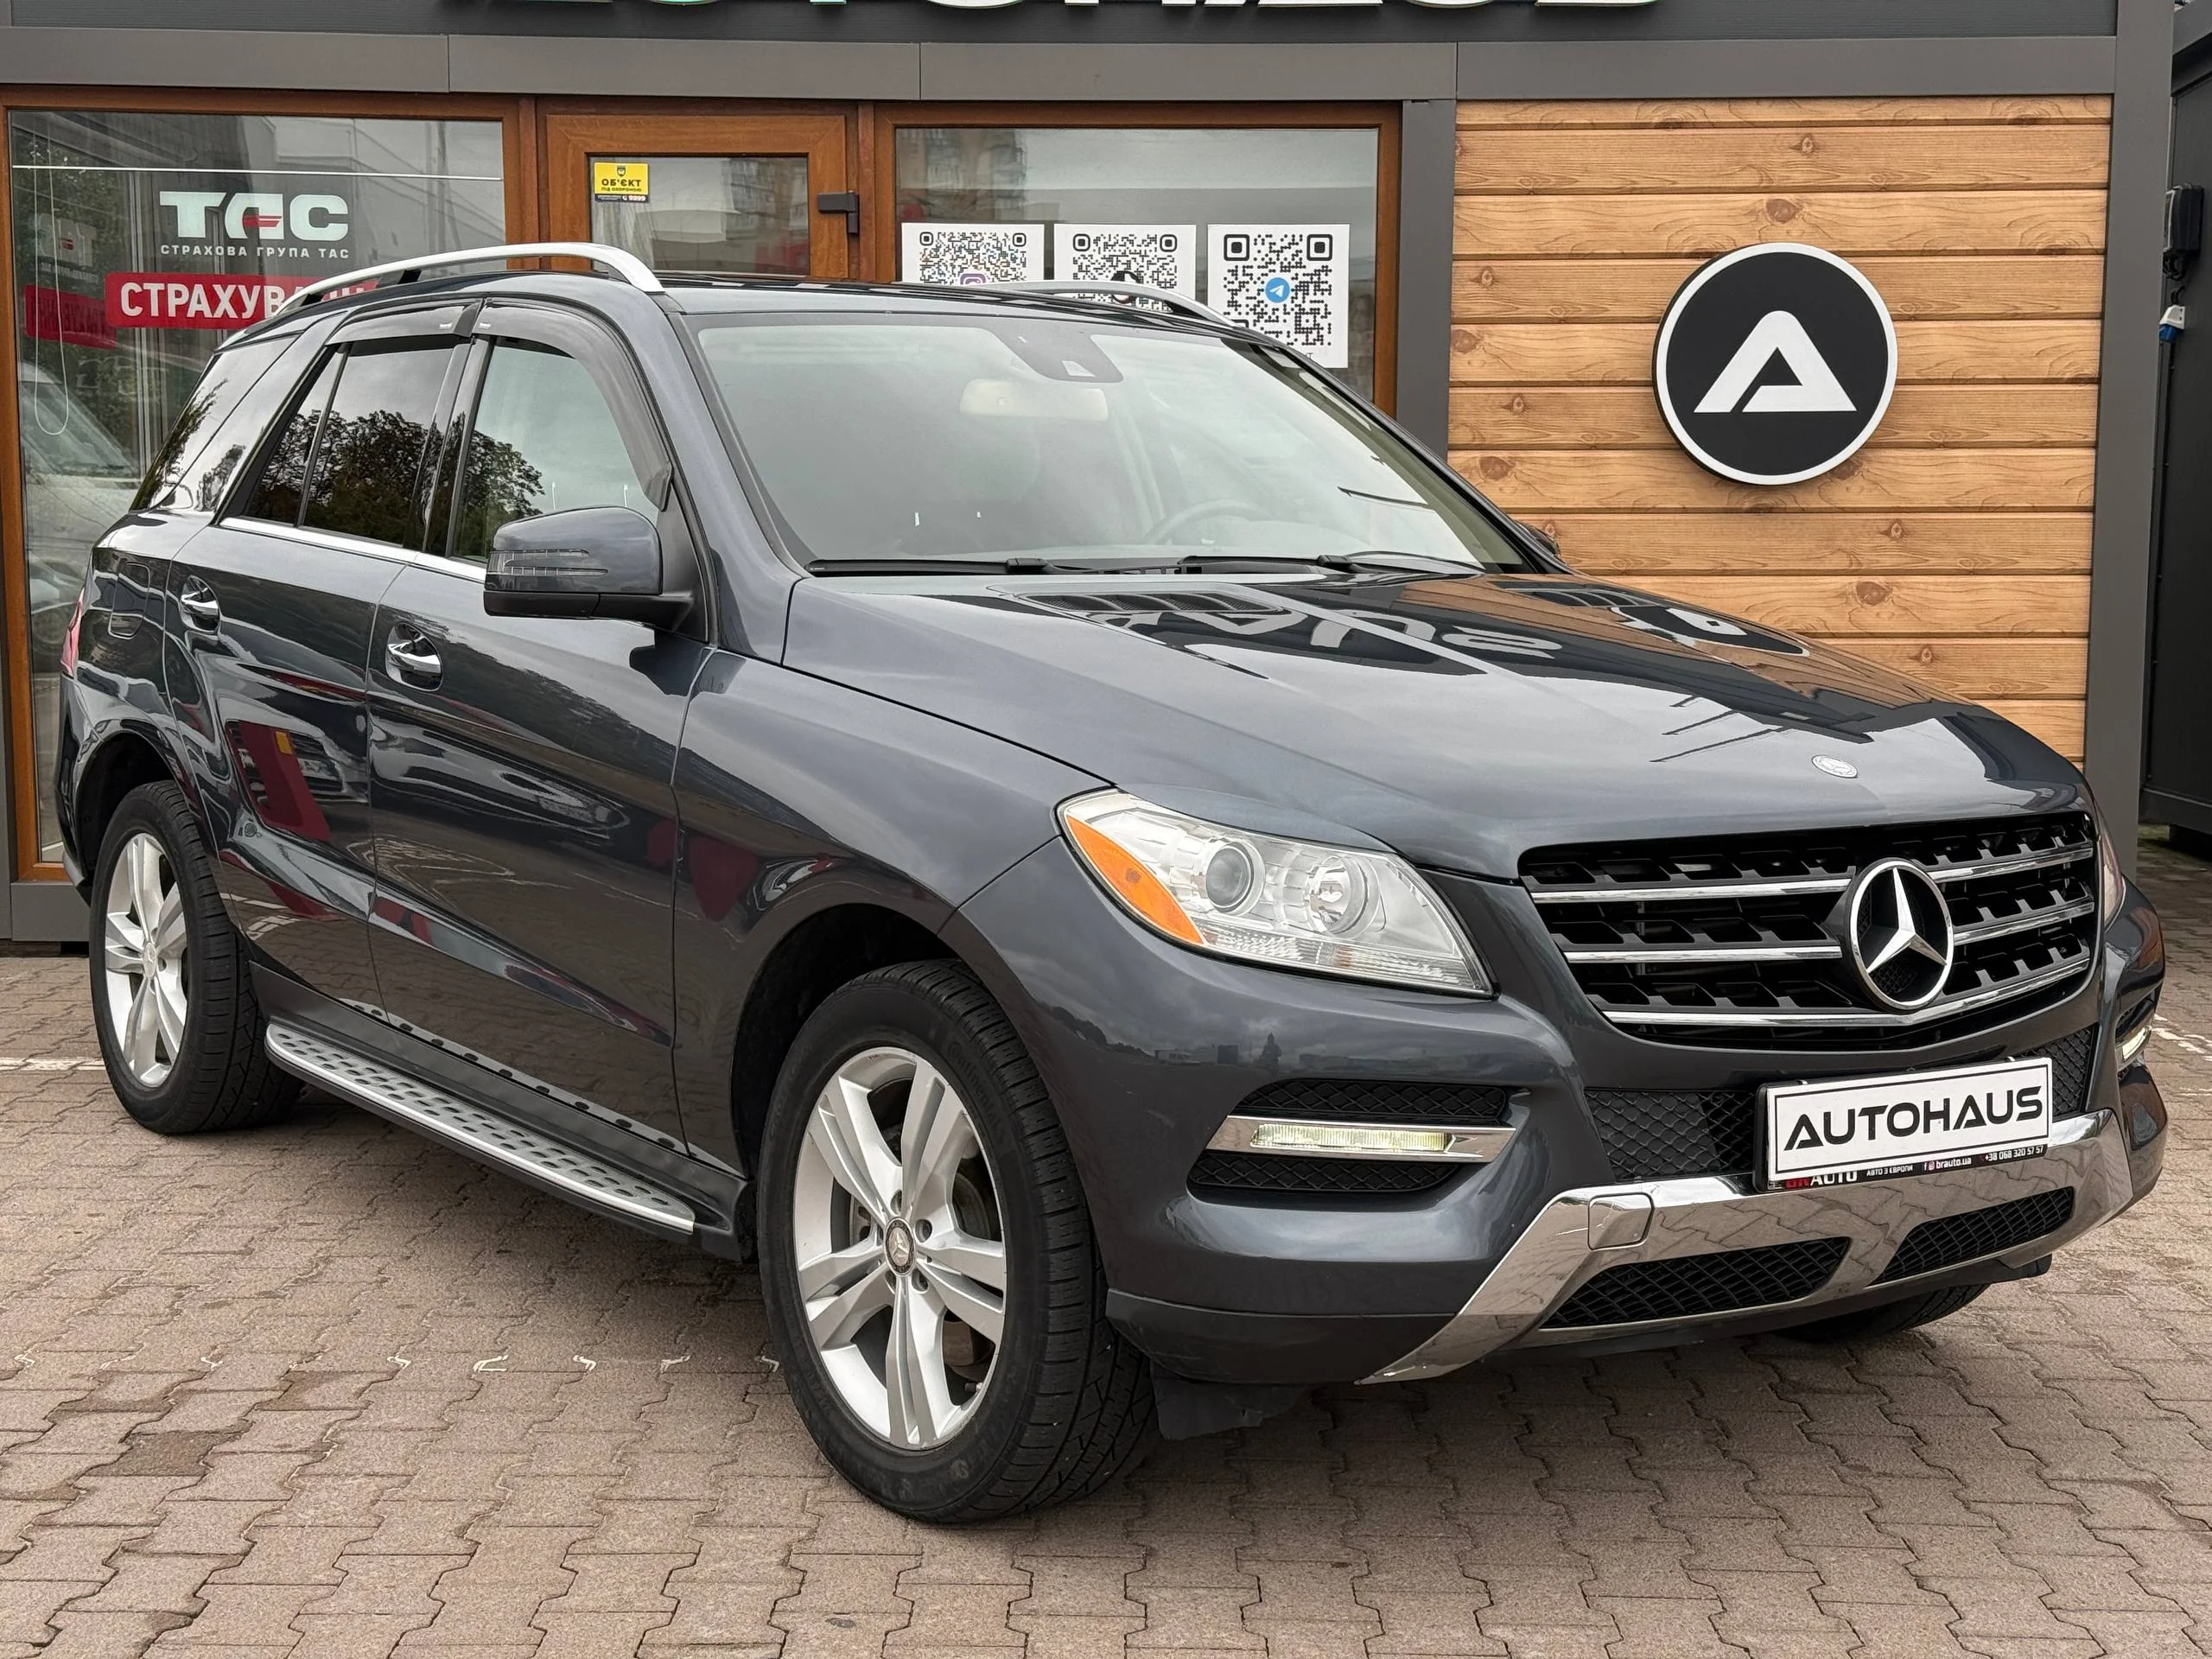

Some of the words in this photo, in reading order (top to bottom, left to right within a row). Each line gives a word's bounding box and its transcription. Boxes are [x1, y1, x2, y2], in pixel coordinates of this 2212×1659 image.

[601, 178, 641, 187] ОБ'ЄКТ
[160, 191, 348, 241] ТАС
[161, 245, 247, 257] СТРАХОВА
[257, 246, 309, 257] ГРУПА
[319, 248, 349, 258] ТАС
[120, 282, 364, 319] СТРАХУВ
[1783, 1086, 2043, 1151] AUTOHAUS
[1986, 1152, 1998, 1161] +38
[1999, 1150, 2012, 1160] 068
[2013, 1148, 2026, 1158] 320
[2027, 1147, 2035, 1156] 57
[2036, 1145, 2044, 1154] 57
[1889, 1165, 1913, 1173] ЄВРОПИ
[1936, 1157, 1972, 1169] brauto.ua
